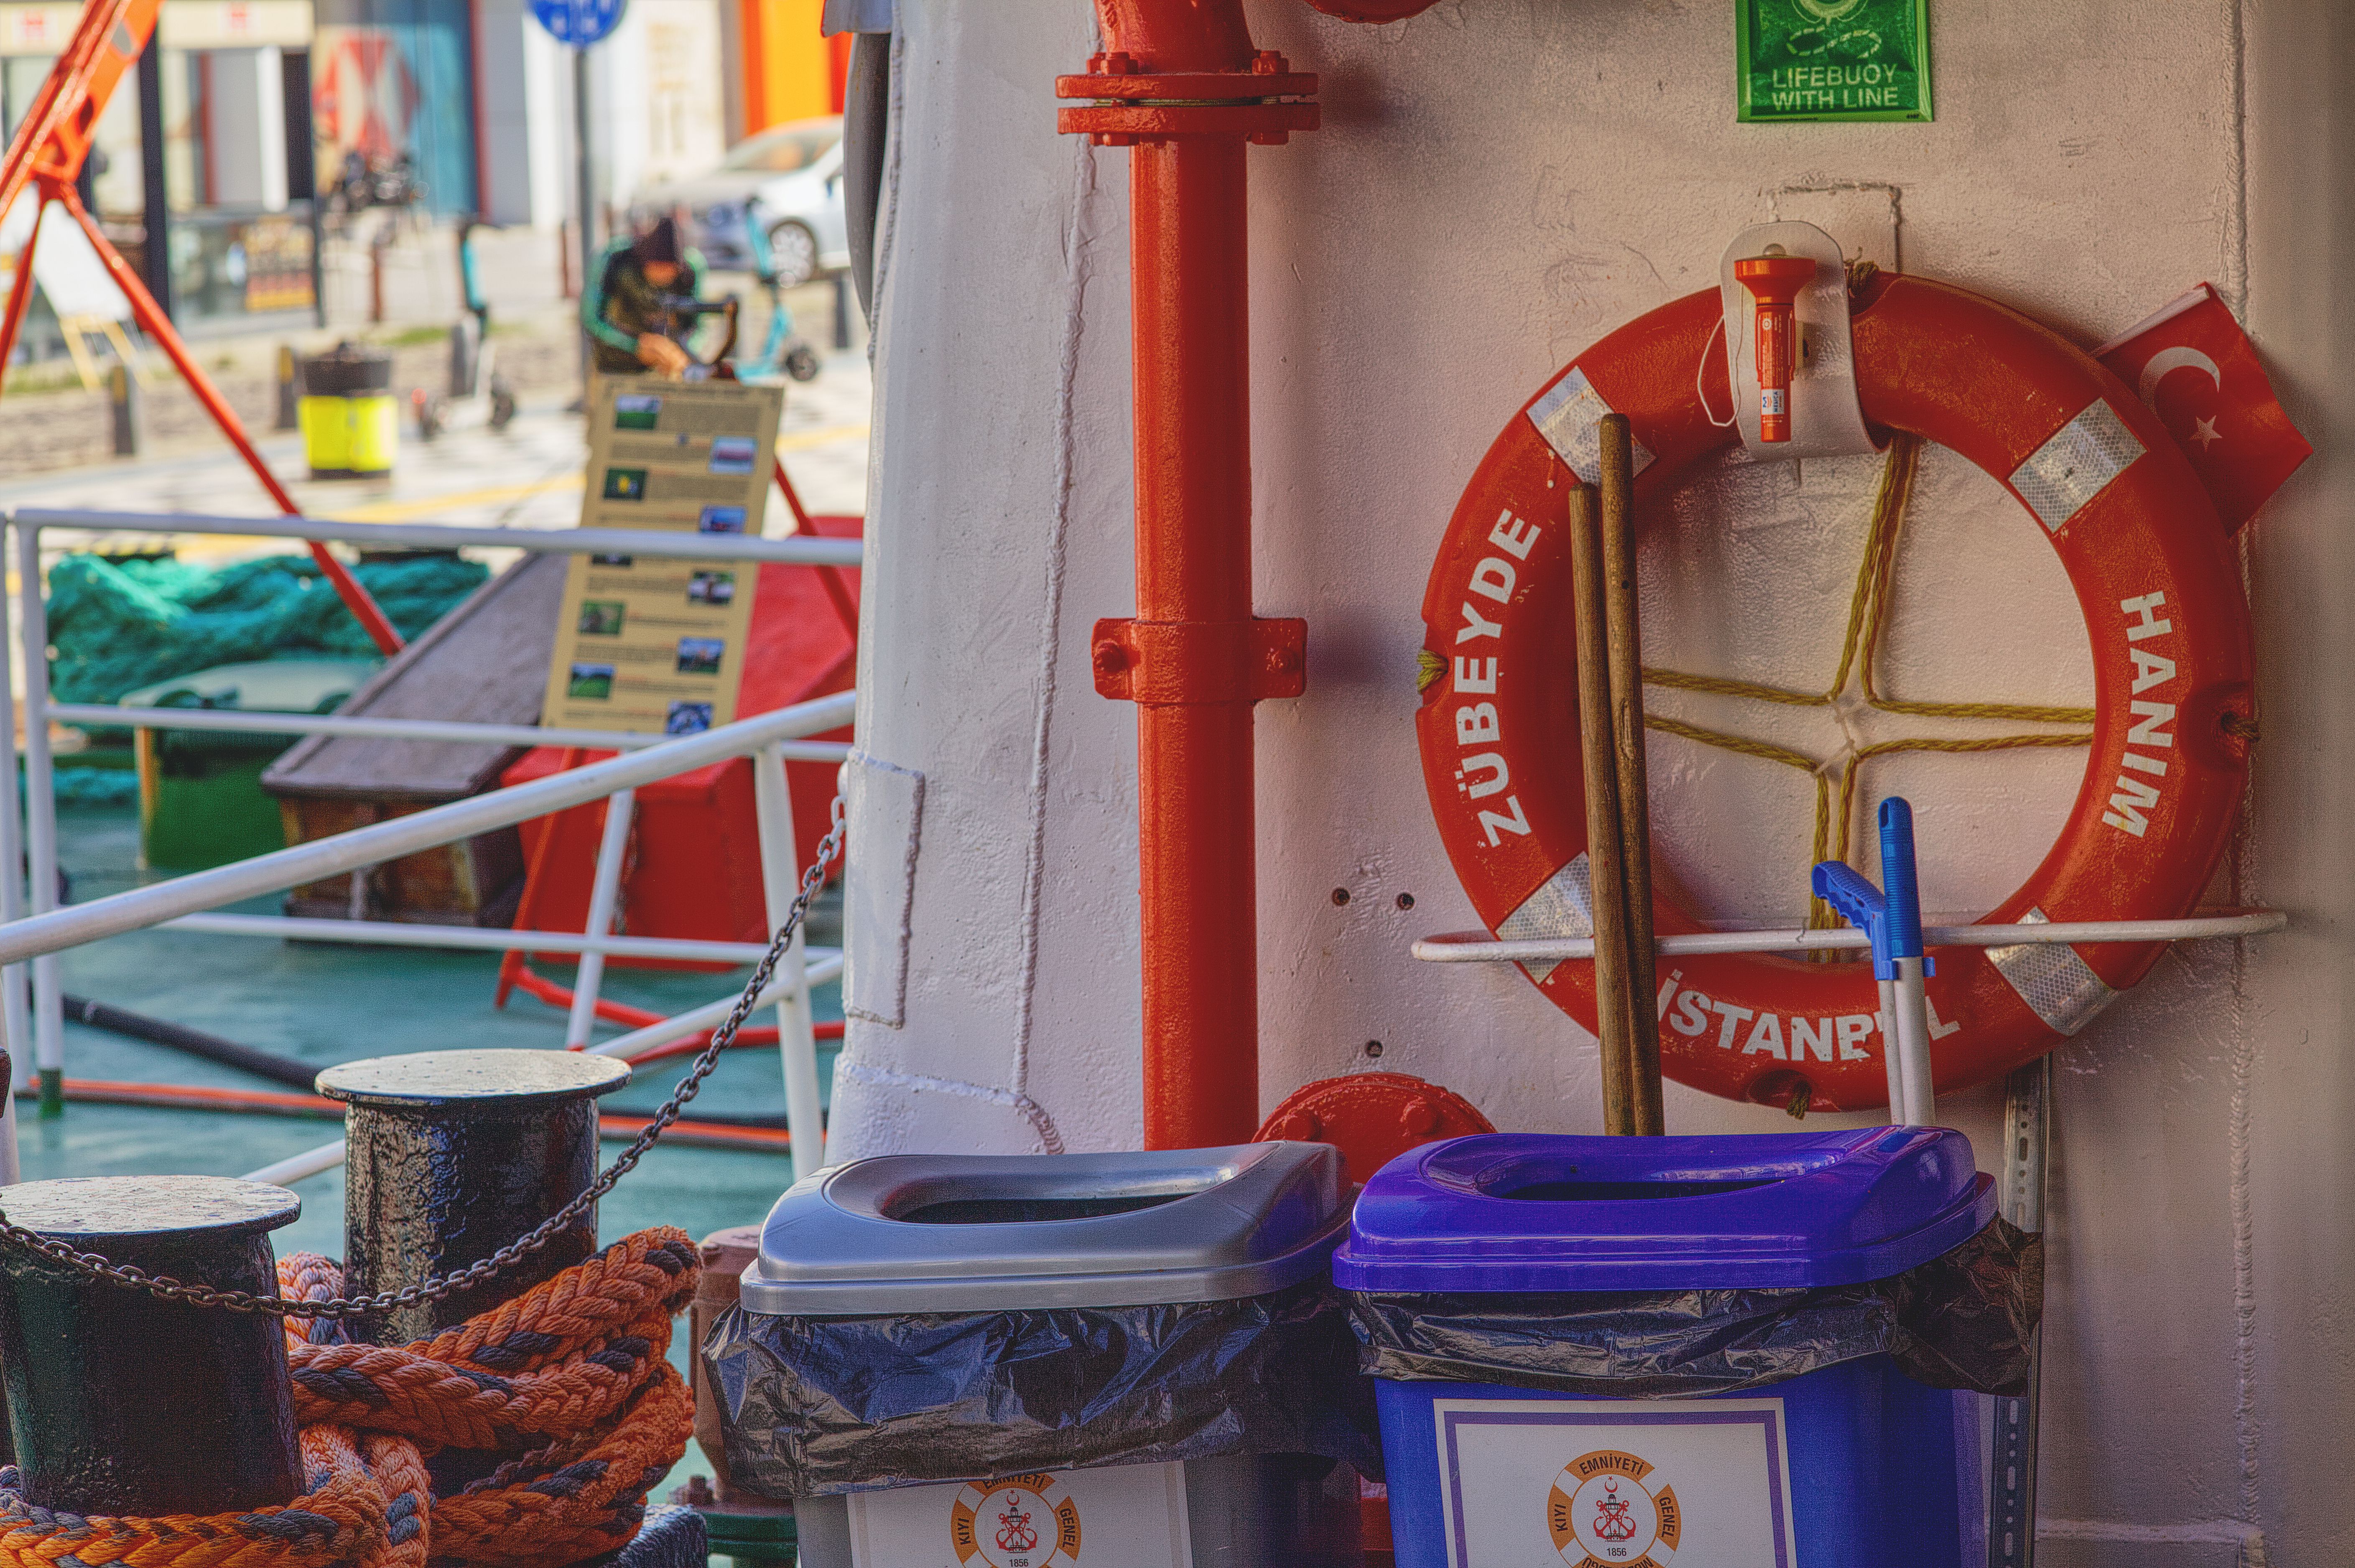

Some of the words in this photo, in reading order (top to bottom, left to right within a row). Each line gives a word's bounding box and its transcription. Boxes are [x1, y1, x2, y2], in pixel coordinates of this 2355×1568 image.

[1772, 64, 1898, 88] LIFEBUOY
[1771, 90, 1834, 111] WITH
[1843, 87, 1899, 108] LINE
[1453, 508, 1542, 848] ZÜBEYDE
[2101, 590, 2176, 837] HANIM
[1657, 968, 1960, 1062] İSTANBL
[1554, 1504, 1568, 1532] KIYI
[1579, 1453, 1645, 1476] EMNİYETİ
[1659, 1497, 1675, 1538] GENEL
[957, 1518, 971, 1545] KIYI
[1060, 1508, 1076, 1547] GENEL
[1009, 1559, 1029, 1567] 1856
[1606, 1548, 1627, 1557] 1856
